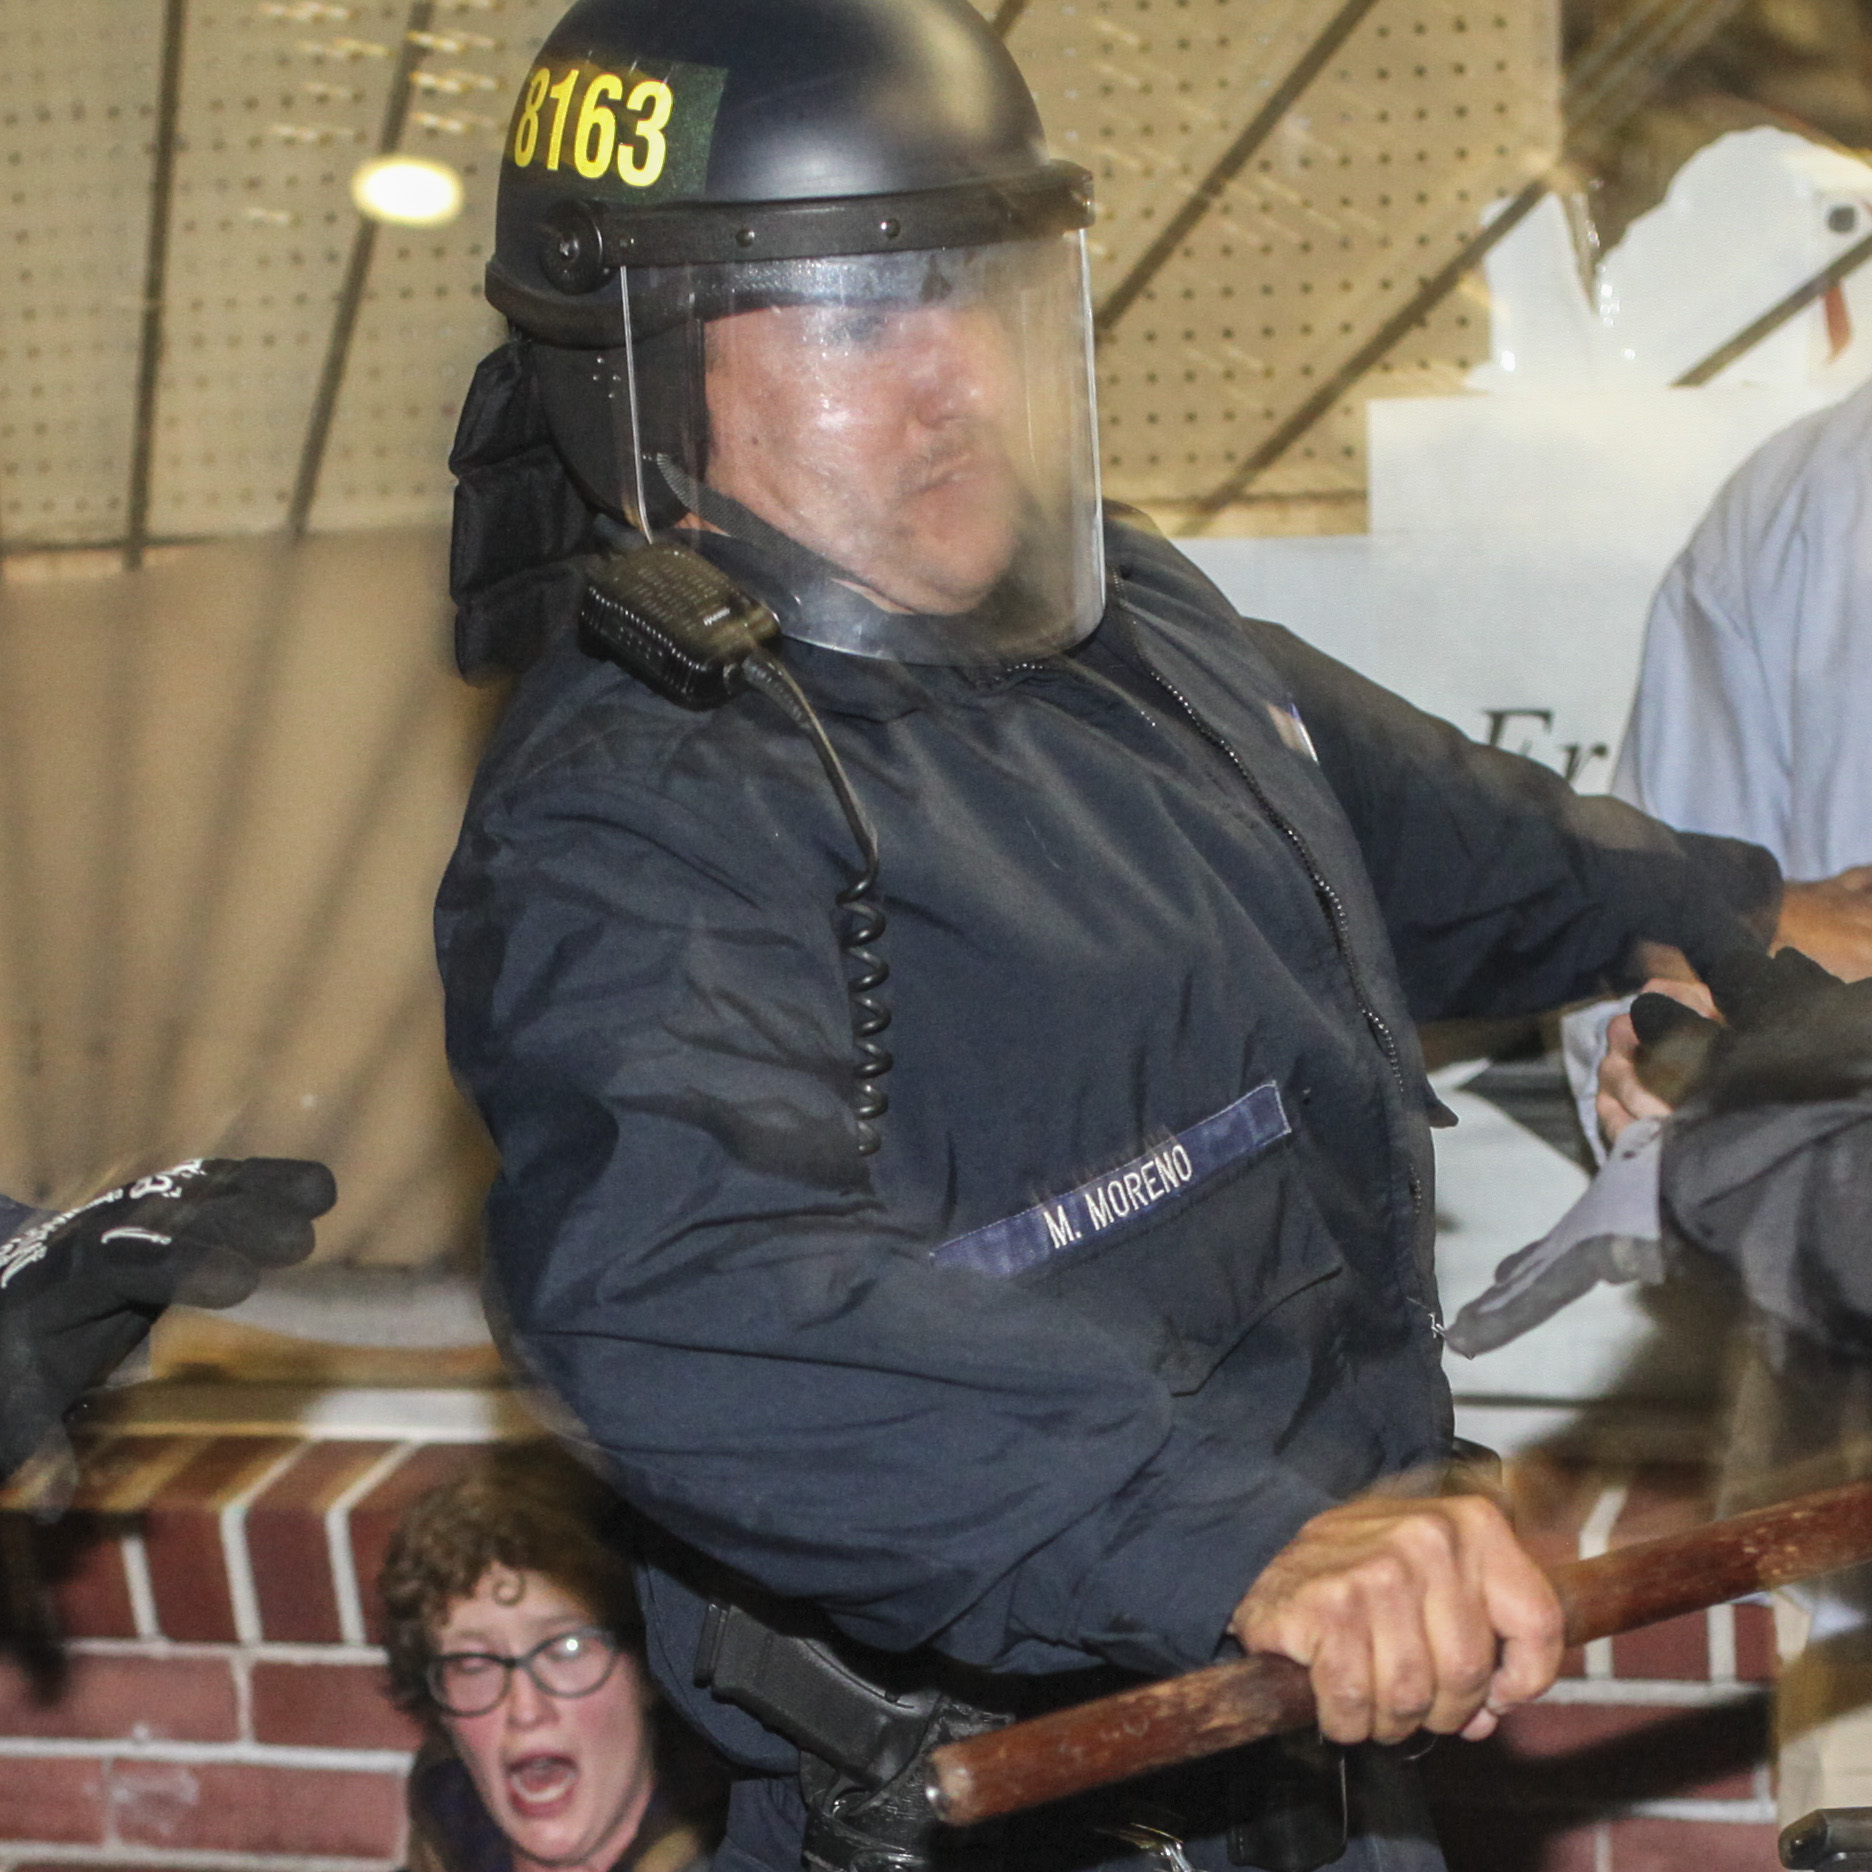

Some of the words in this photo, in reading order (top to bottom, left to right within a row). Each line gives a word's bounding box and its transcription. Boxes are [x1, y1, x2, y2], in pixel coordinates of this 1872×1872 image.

[514, 67, 674, 187] 8163
[1042, 1204, 1083, 1250] M.
[1084, 1143, 1193, 1232] MORENO
